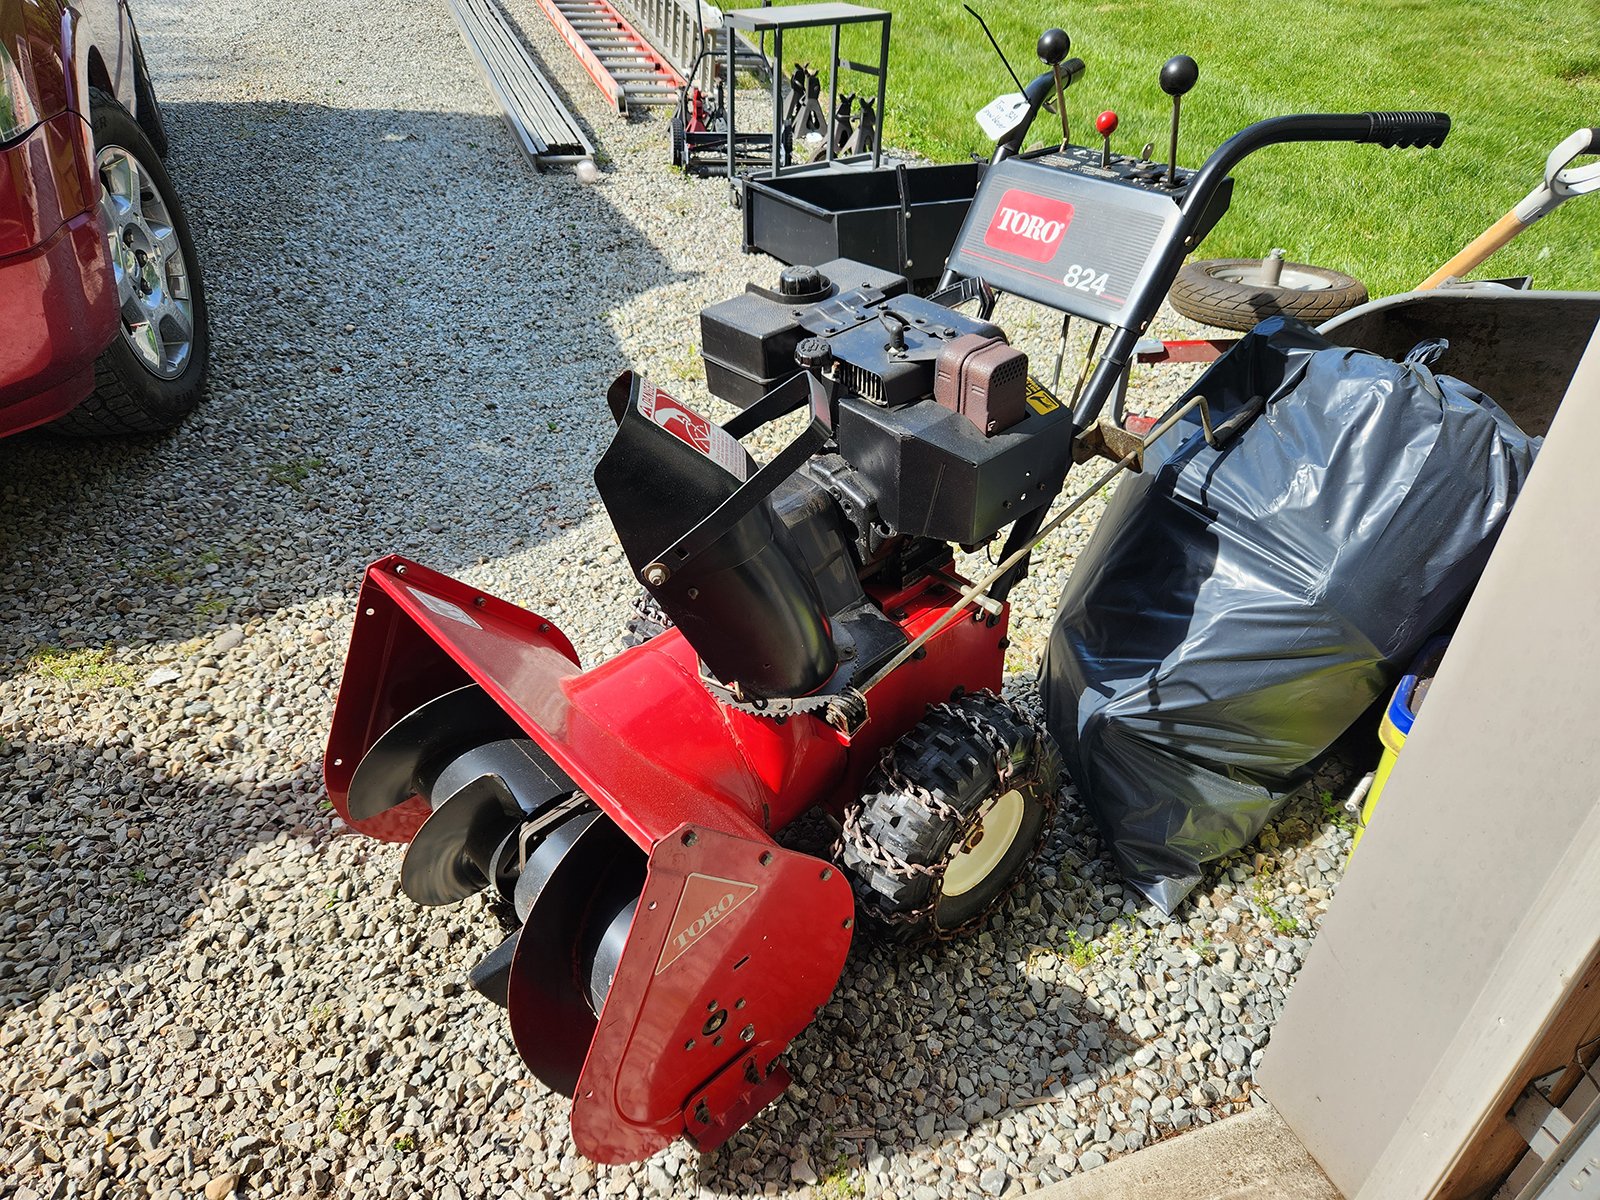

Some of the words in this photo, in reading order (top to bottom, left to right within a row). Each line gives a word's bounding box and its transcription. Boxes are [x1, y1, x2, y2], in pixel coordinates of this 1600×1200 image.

[997, 207, 1062, 244] TORO
[1063, 264, 1109, 296] 824
[672, 893, 735, 949] TORO
